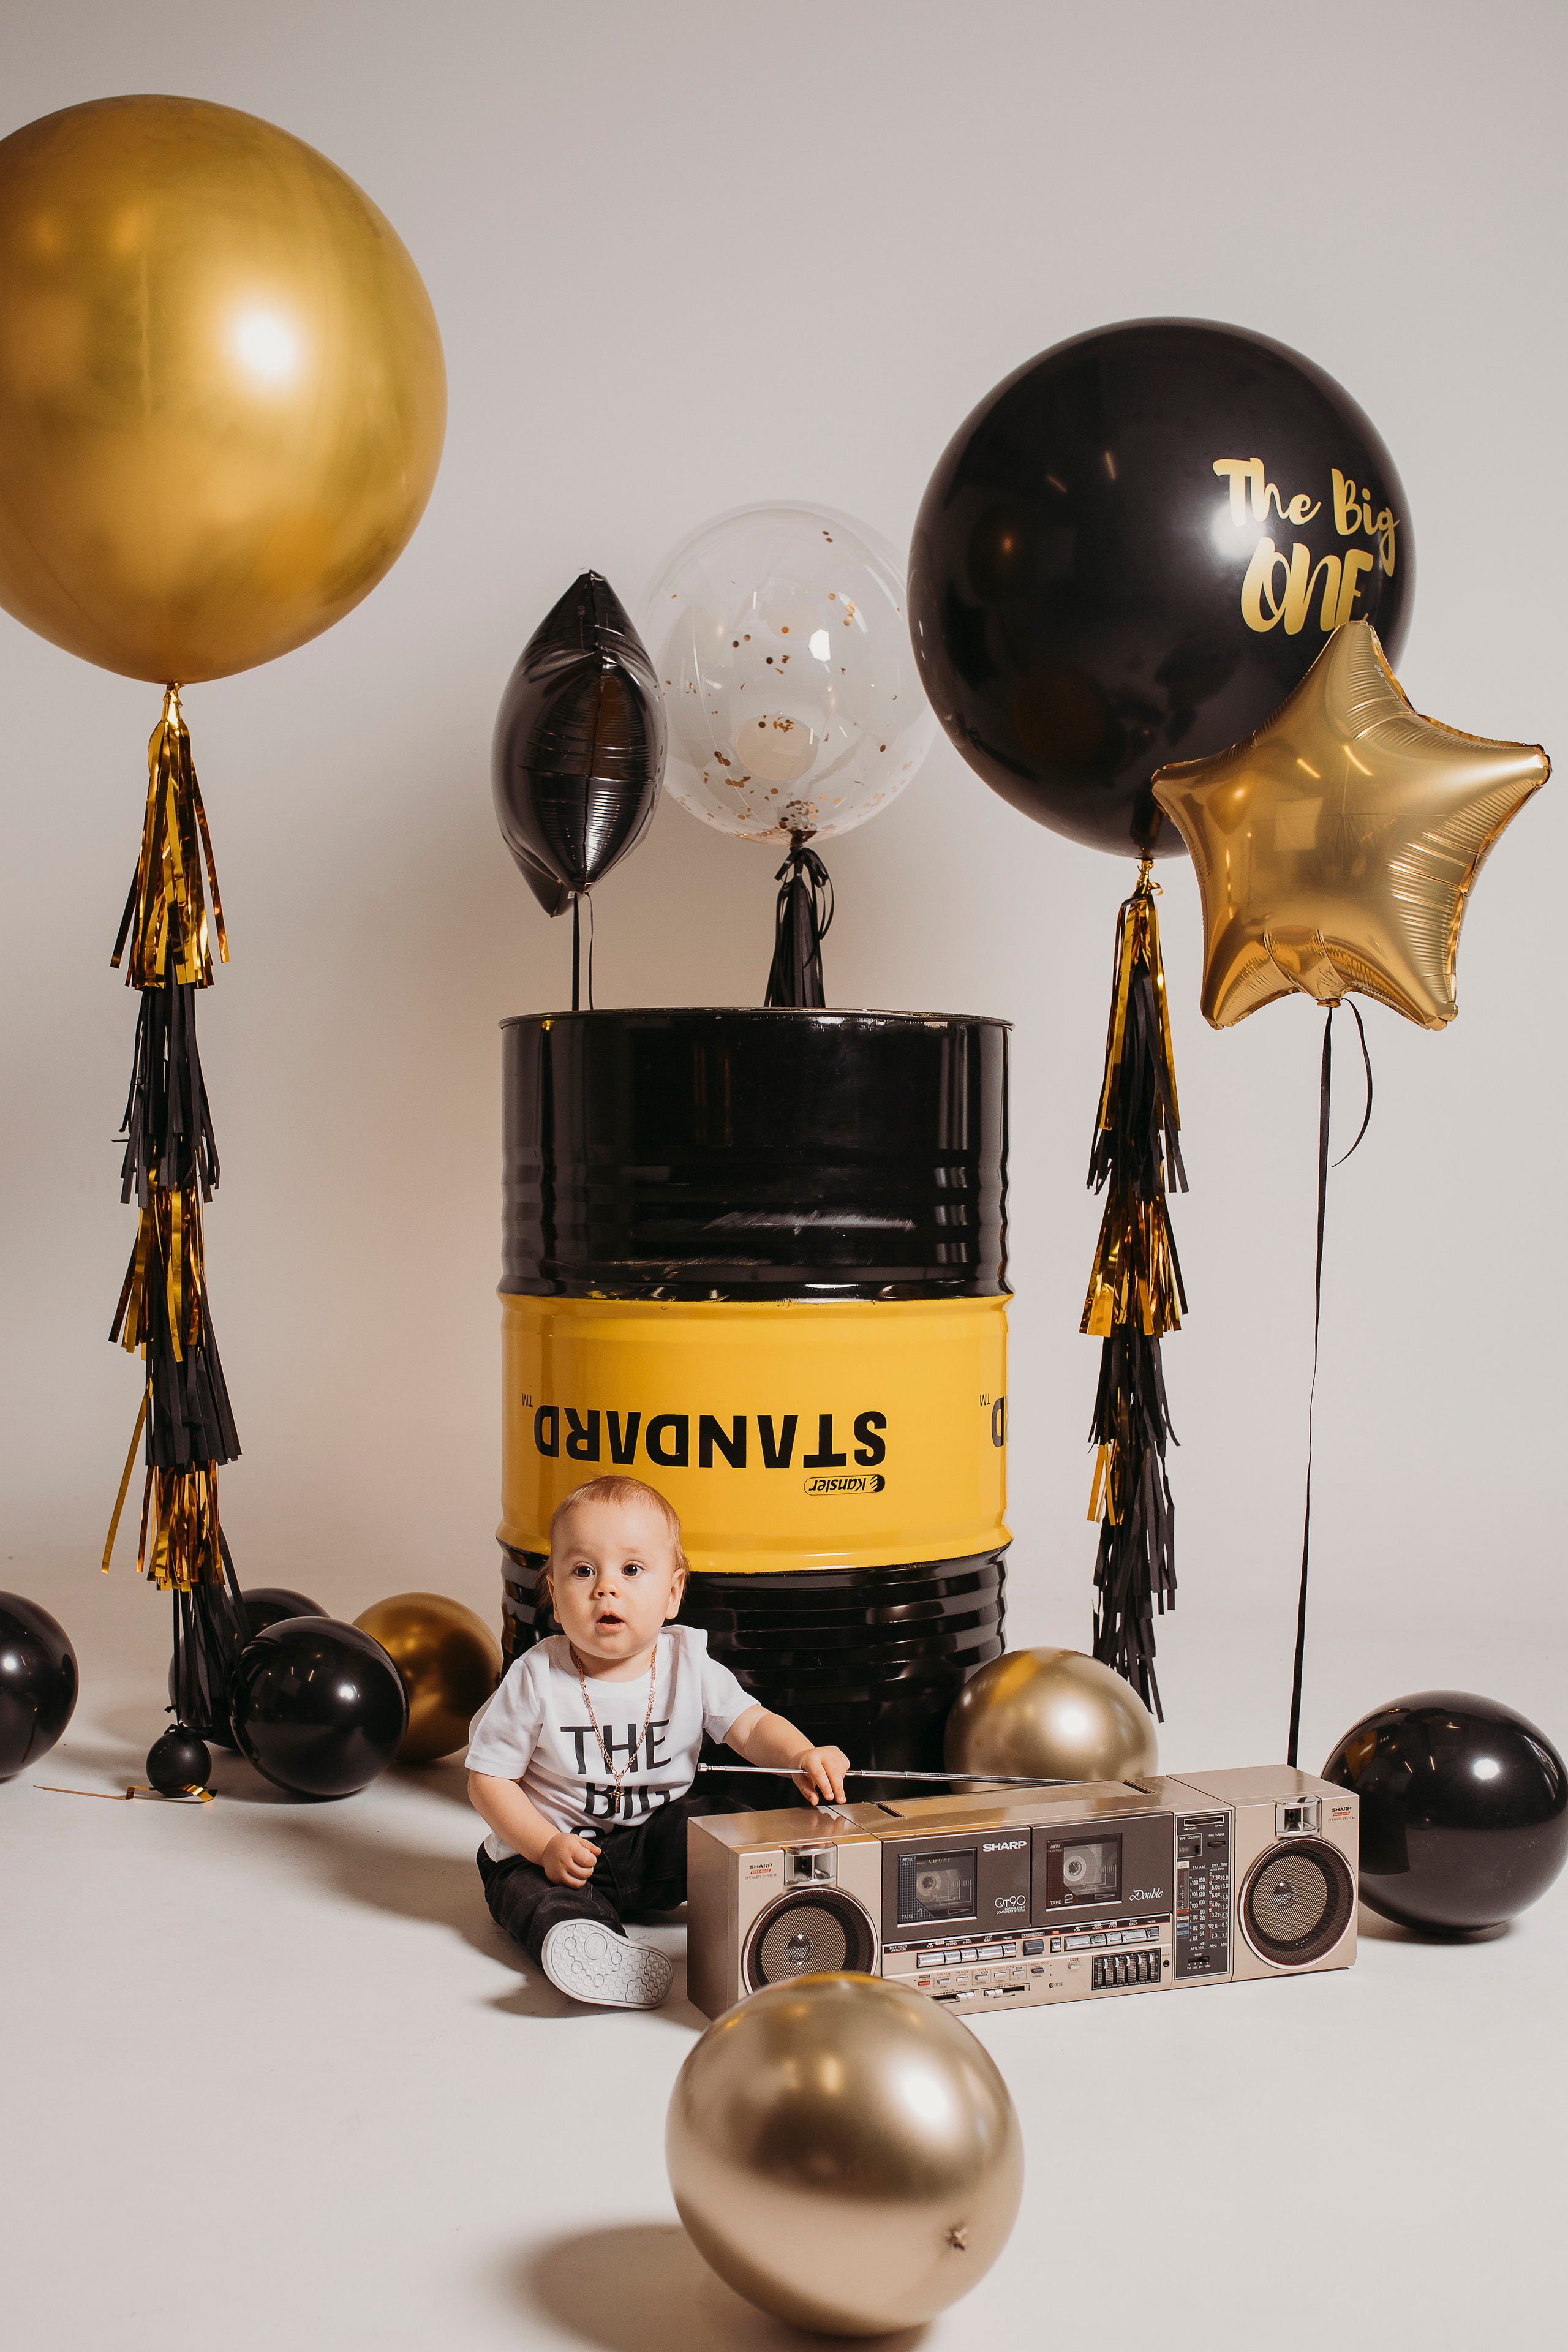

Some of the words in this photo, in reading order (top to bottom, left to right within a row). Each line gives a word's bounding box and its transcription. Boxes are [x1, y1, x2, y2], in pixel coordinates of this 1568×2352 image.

[1213, 458, 1321, 527] The
[1332, 468, 1400, 577] Big
[534, 1404, 887, 1469] STANDARD
[809, 1477, 866, 1493] Kansler
[560, 1719, 671, 1774] THE
[982, 1841, 1027, 1852] SHARP
[1065, 1894, 1073, 1904] 2
[1129, 1887, 1163, 1901] Double
[917, 1908, 922, 1918] 1
